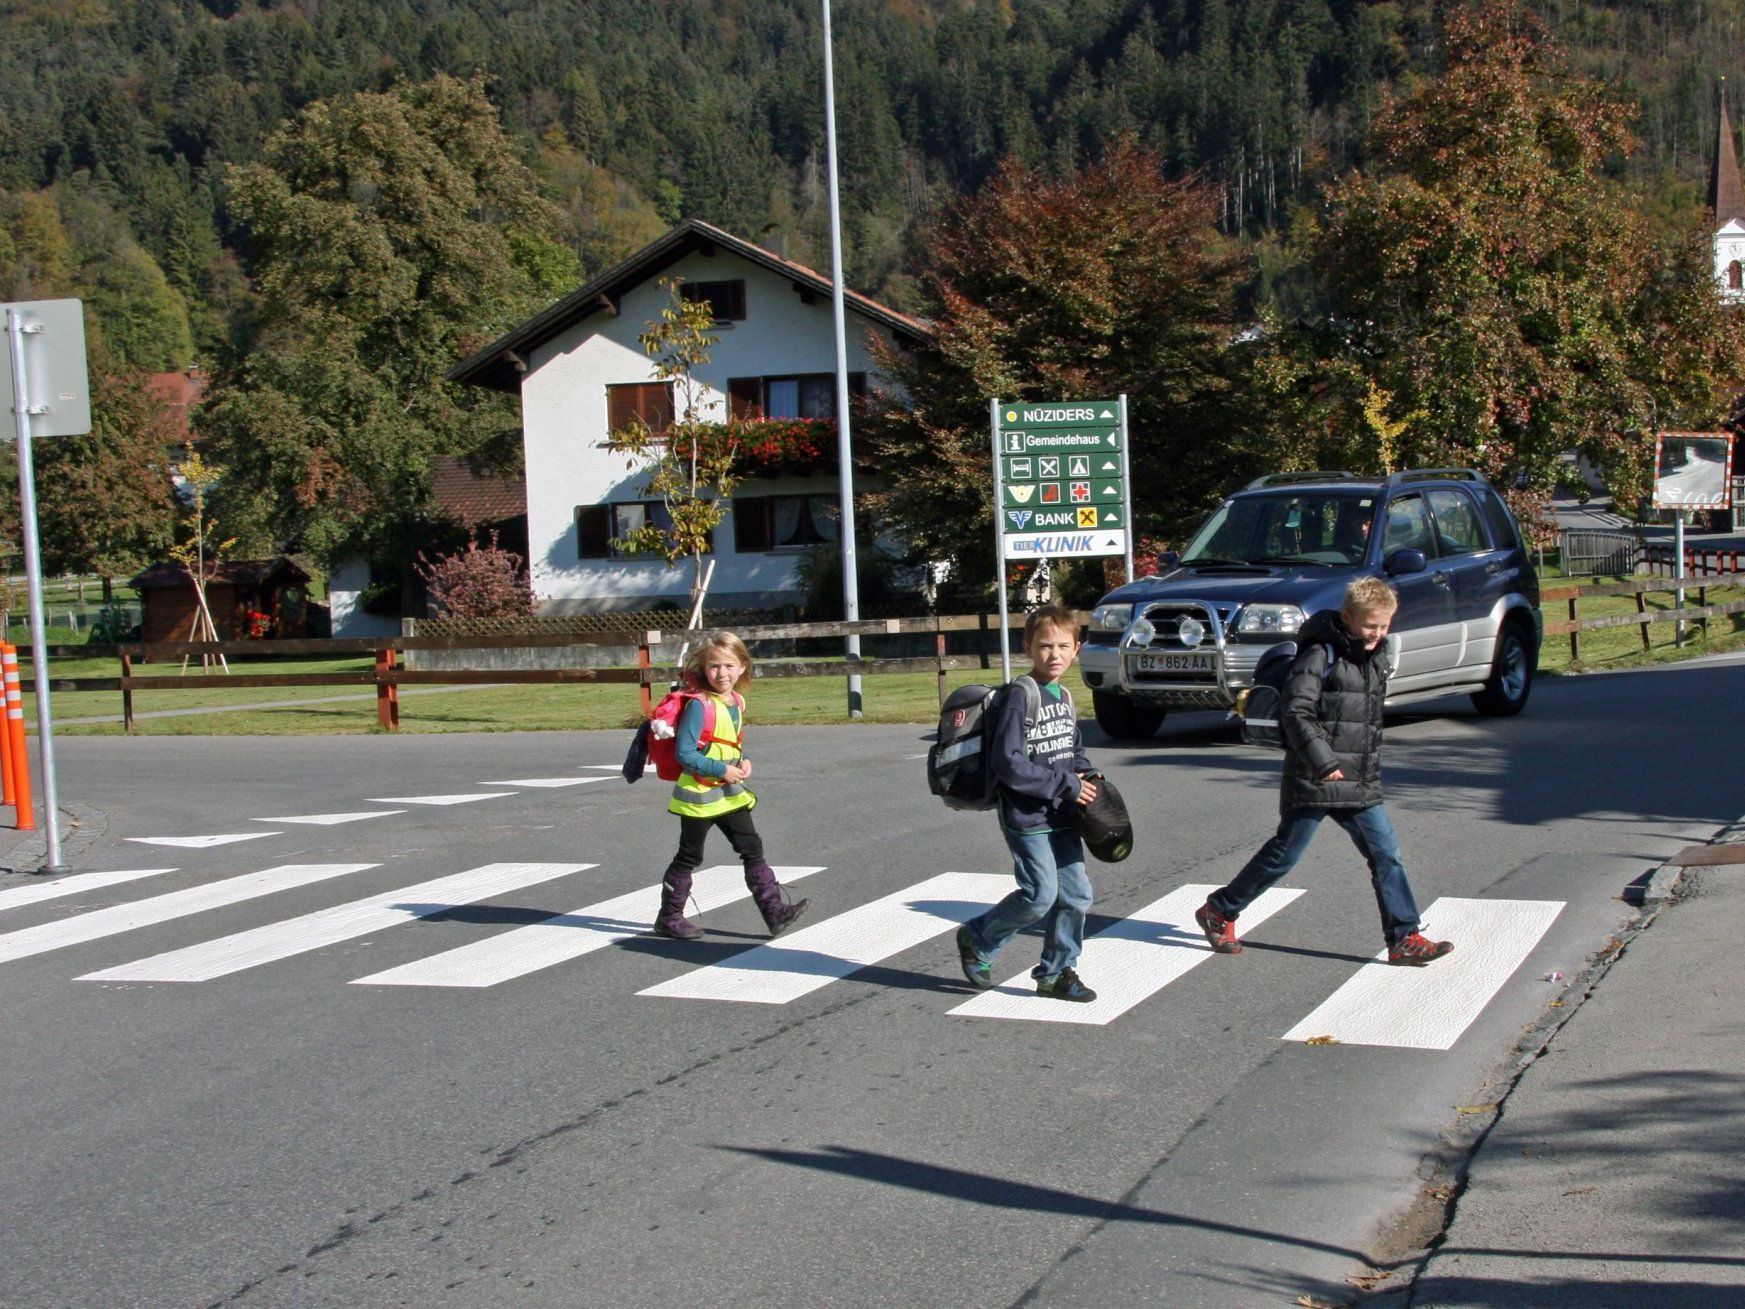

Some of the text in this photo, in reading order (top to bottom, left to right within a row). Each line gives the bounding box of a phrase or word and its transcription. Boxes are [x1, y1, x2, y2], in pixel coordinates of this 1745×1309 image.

[1024, 408, 1094, 422] NÜZIDERS
[1026, 434, 1100, 446] Gemeindehaus
[1035, 513, 1075, 525] BANK
[1141, 656, 1155, 668] BZ
